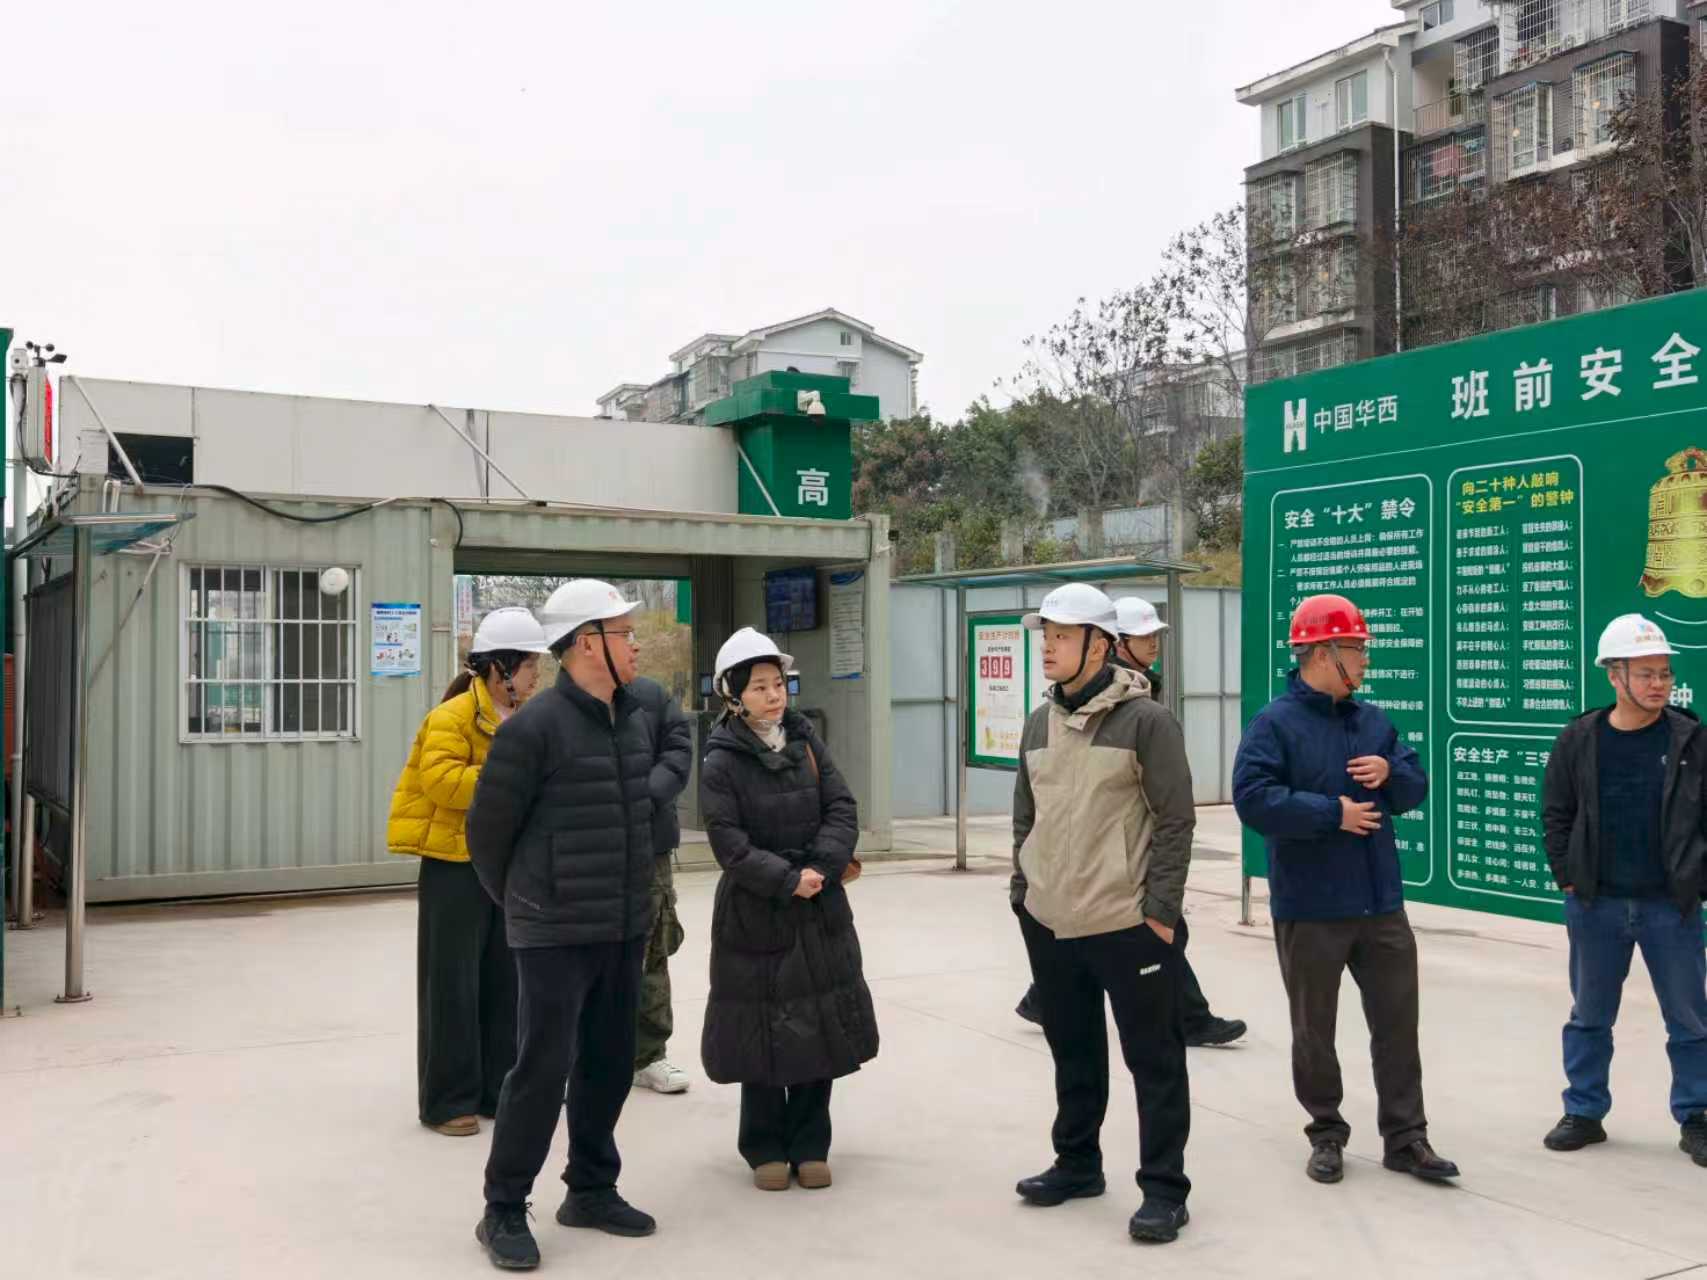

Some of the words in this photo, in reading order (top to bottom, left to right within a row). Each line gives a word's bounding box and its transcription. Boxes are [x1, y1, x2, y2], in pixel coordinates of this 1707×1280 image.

[1451, 332, 1701, 419] 班前安全
[1313, 395, 1398, 434] 中国华西
[796, 468, 830, 506] 高
